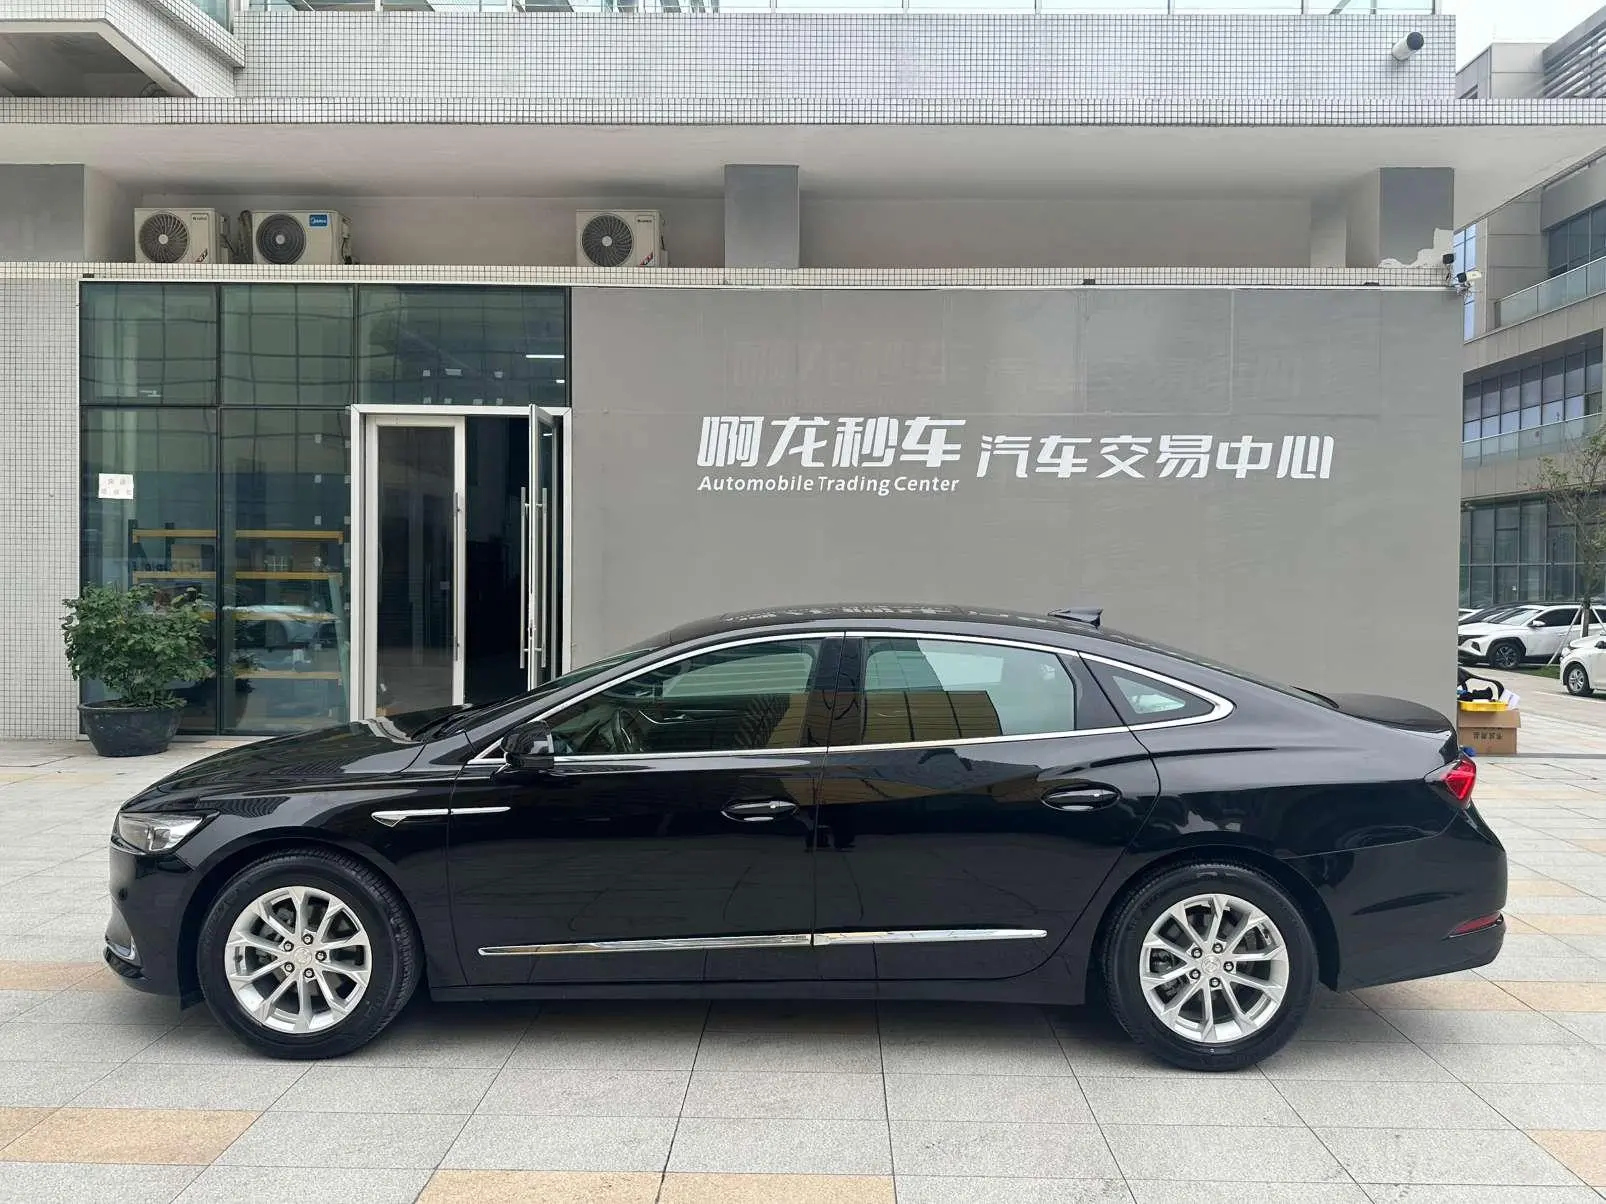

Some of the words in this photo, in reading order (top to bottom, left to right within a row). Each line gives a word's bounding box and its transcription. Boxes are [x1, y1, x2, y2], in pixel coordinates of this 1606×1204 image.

[696, 416, 967, 468] 啊龙秒车
[976, 434, 1335, 479] 汽车交易中心
[697, 475, 814, 492] Automobile
[817, 475, 891, 497] Trading
[893, 475, 960, 492] Center
